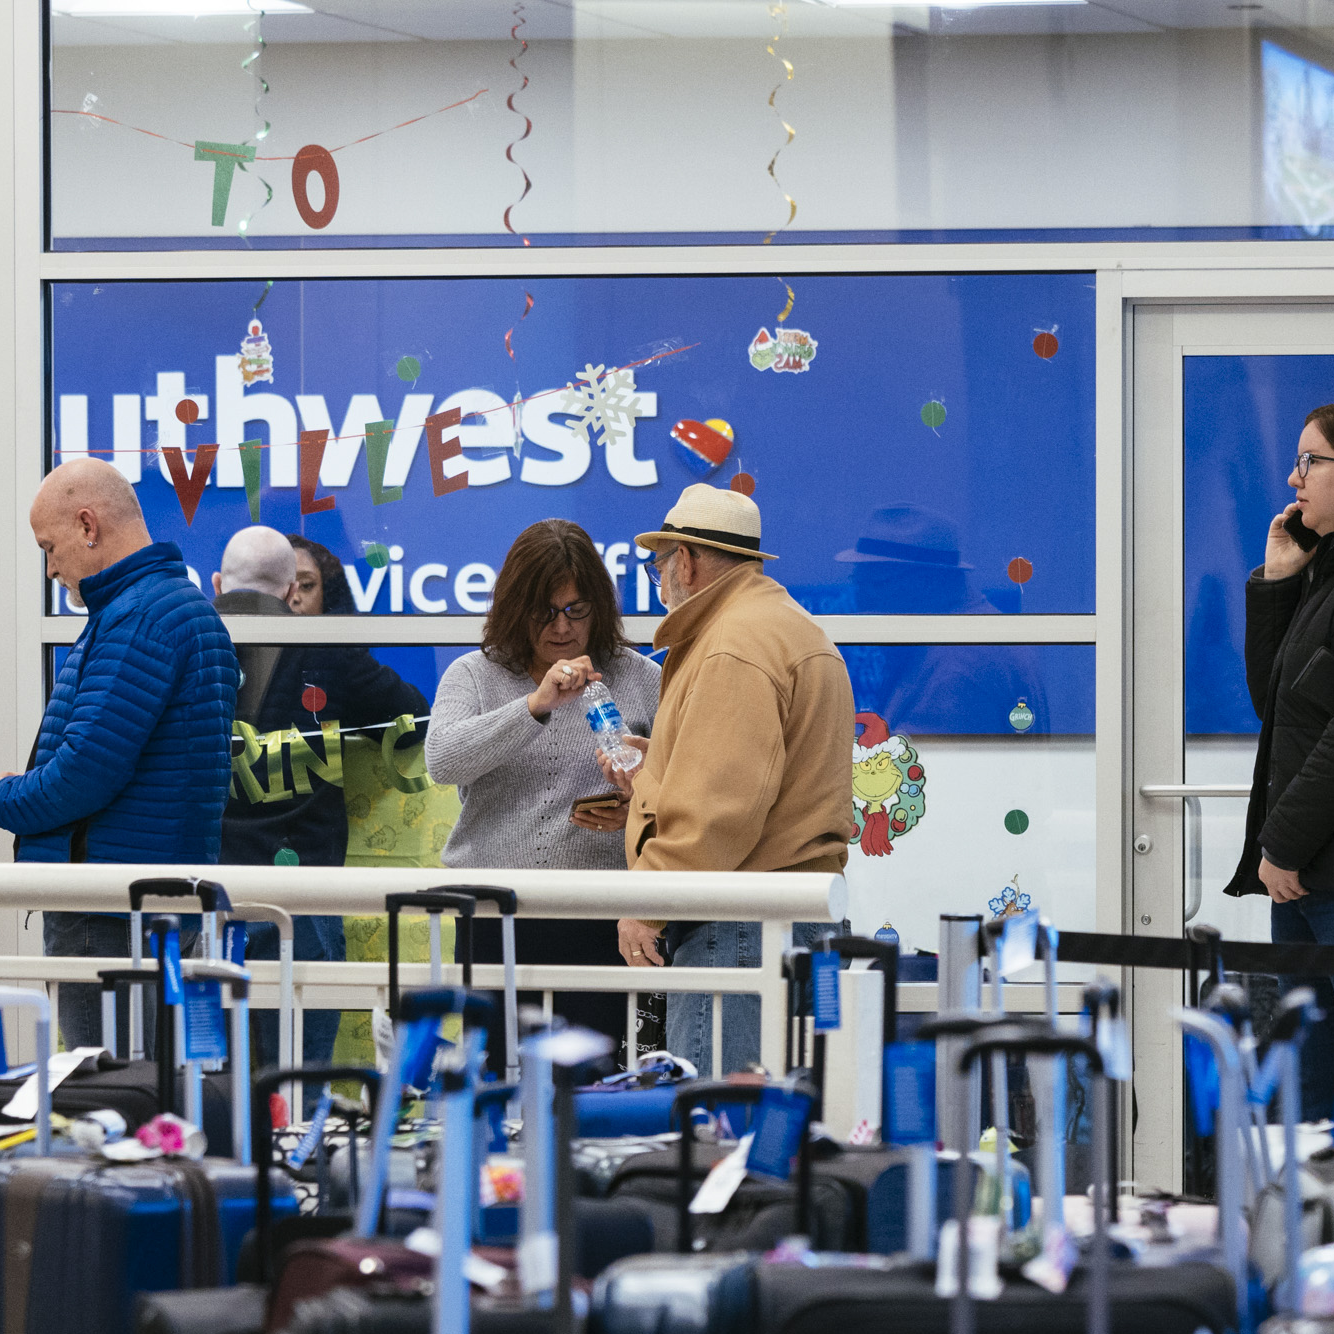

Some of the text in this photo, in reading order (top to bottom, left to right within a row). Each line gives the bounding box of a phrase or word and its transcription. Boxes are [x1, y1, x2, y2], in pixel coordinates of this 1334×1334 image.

[194, 141, 340, 230] TO
[161, 406, 469, 528] VILLE
[345, 545, 498, 614] vice
[1009, 712, 1033, 722] GRINCH
